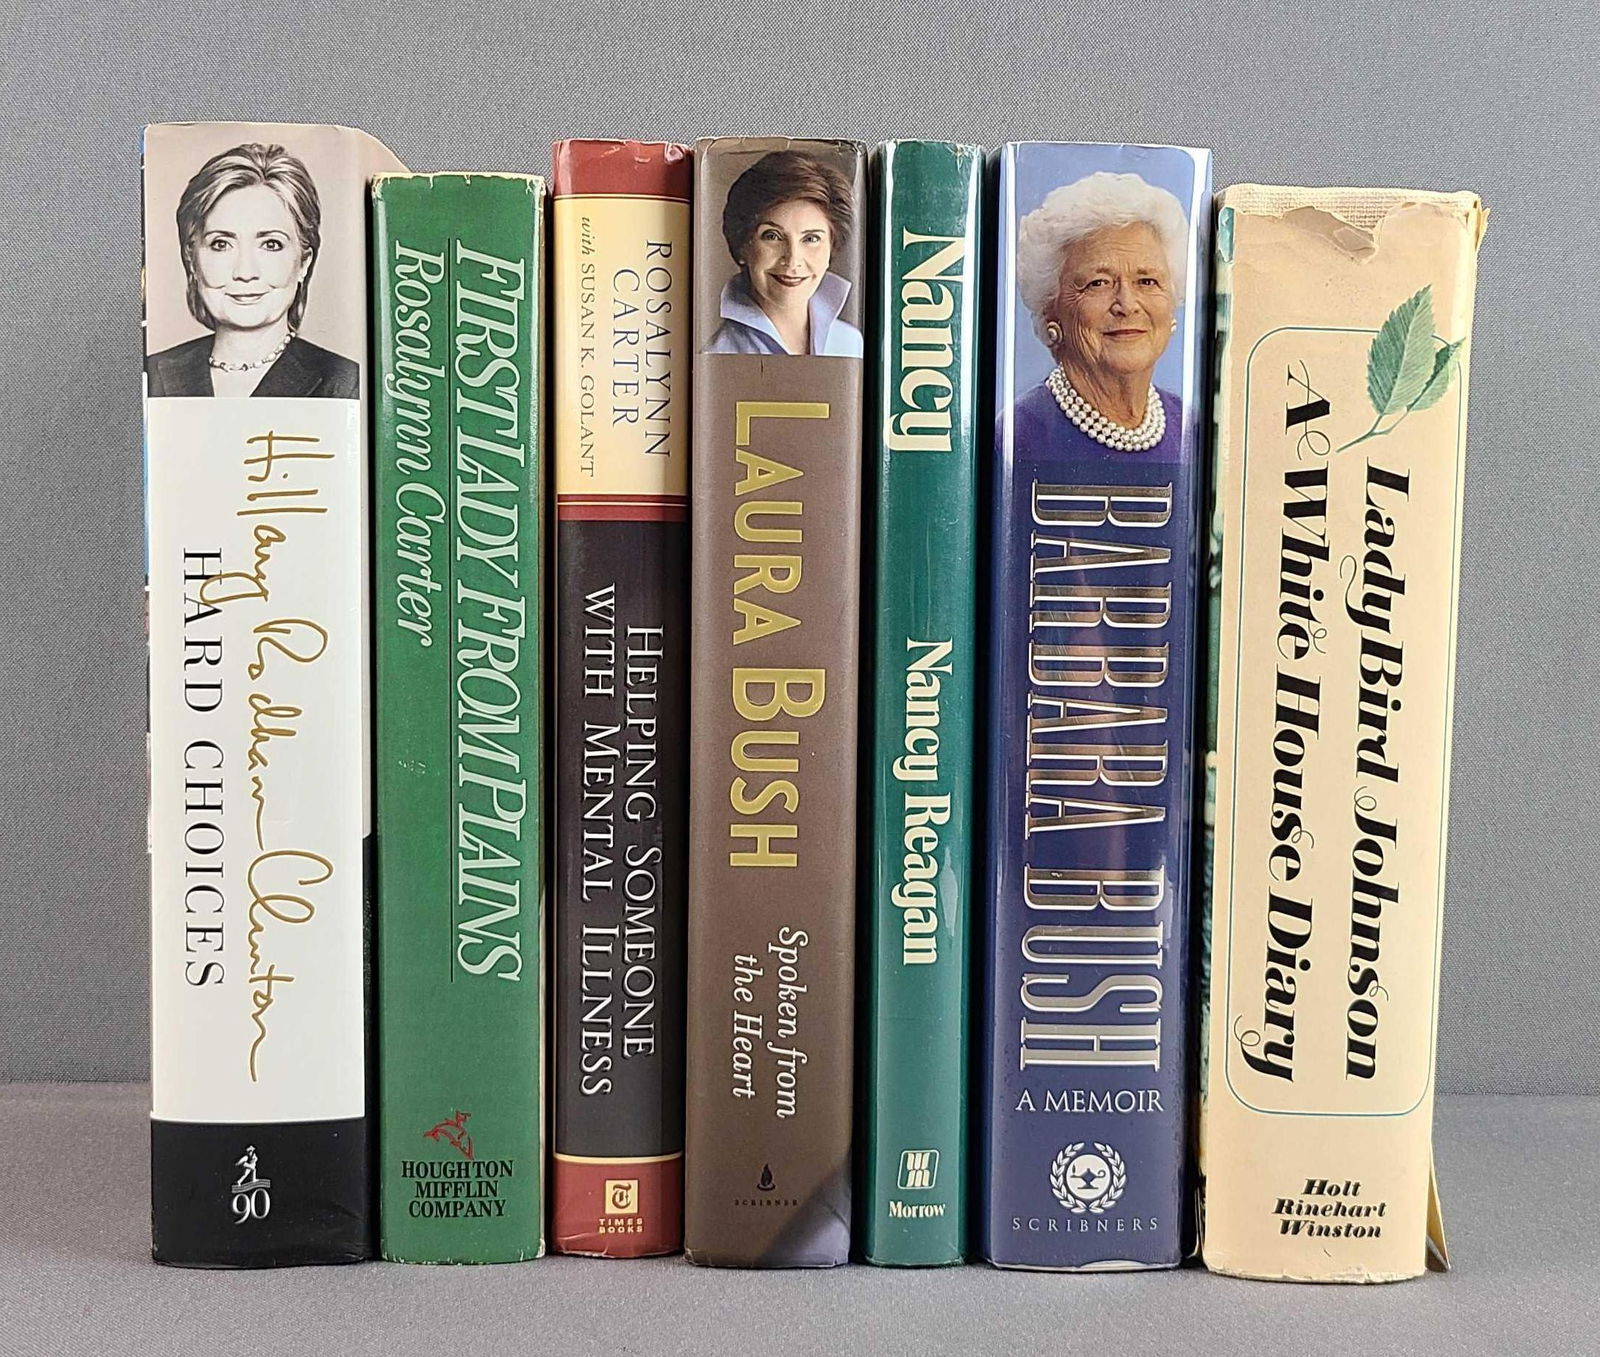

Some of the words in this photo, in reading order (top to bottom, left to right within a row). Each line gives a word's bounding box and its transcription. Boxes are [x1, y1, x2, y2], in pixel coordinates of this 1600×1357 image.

[581, 216, 597, 256] with
[581, 263, 596, 340] SUSAN
[384, 240, 445, 475] Rosalynn
[456, 239, 525, 439] FIRST
[580, 346, 596, 368] K.
[612, 268, 641, 427] CARTER
[645, 240, 673, 458] ROSALYNN
[883, 226, 966, 452] Nancy
[1285, 359, 1331, 461] A
[580, 374, 596, 477] GOLANT
[396, 482, 447, 648] Carter
[456, 426, 526, 588] LADY
[732, 401, 830, 646] LAURA
[1276, 460, 1332, 660] White
[183, 547, 223, 713] HARD
[456, 579, 527, 773] FROM
[583, 583, 616, 698] WITH
[892, 636, 954, 783] Nancy
[1024, 478, 1173, 840] BARBARA
[625, 625, 664, 823] HELPING
[729, 667, 827, 868] BUSH
[1267, 662, 1322, 883] House
[183, 739, 226, 986] CHOICES
[457, 763, 527, 982] PLAINS
[582, 720, 621, 902] MENTAL
[890, 791, 951, 966] Reagan
[247, 850, 334, 1082] Clinton
[580, 924, 620, 1096] ILLNESS
[623, 845, 662, 1058] SOMEONE
[732, 953, 764, 1002] the
[768, 926, 809, 1039] Spoken
[1019, 863, 1166, 1072] BUSH
[1233, 886, 1314, 1083] Diary
[1345, 785, 1399, 1081] Johnson
[732, 1014, 764, 1099] Heart
[766, 1042, 808, 1119] from
[1015, 1090, 1036, 1111] A
[1044, 1089, 1164, 1113] MEMOIR
[231, 1189, 272, 1225] 90
[401, 1160, 514, 1179] HOUGHTON
[408, 1200, 506, 1218] COMPANY
[415, 1180, 499, 1199] MIFFLIN
[599, 1218, 643, 1226] TIMES
[599, 1225, 643, 1234] BOOKS
[888, 1201, 946, 1218] Morrow
[1012, 1217, 1159, 1232] SCRIBNERS
[1271, 1198, 1386, 1217] Rinehart
[1279, 1218, 1382, 1238] Winston
[1300, 1178, 1361, 1197] Holt
